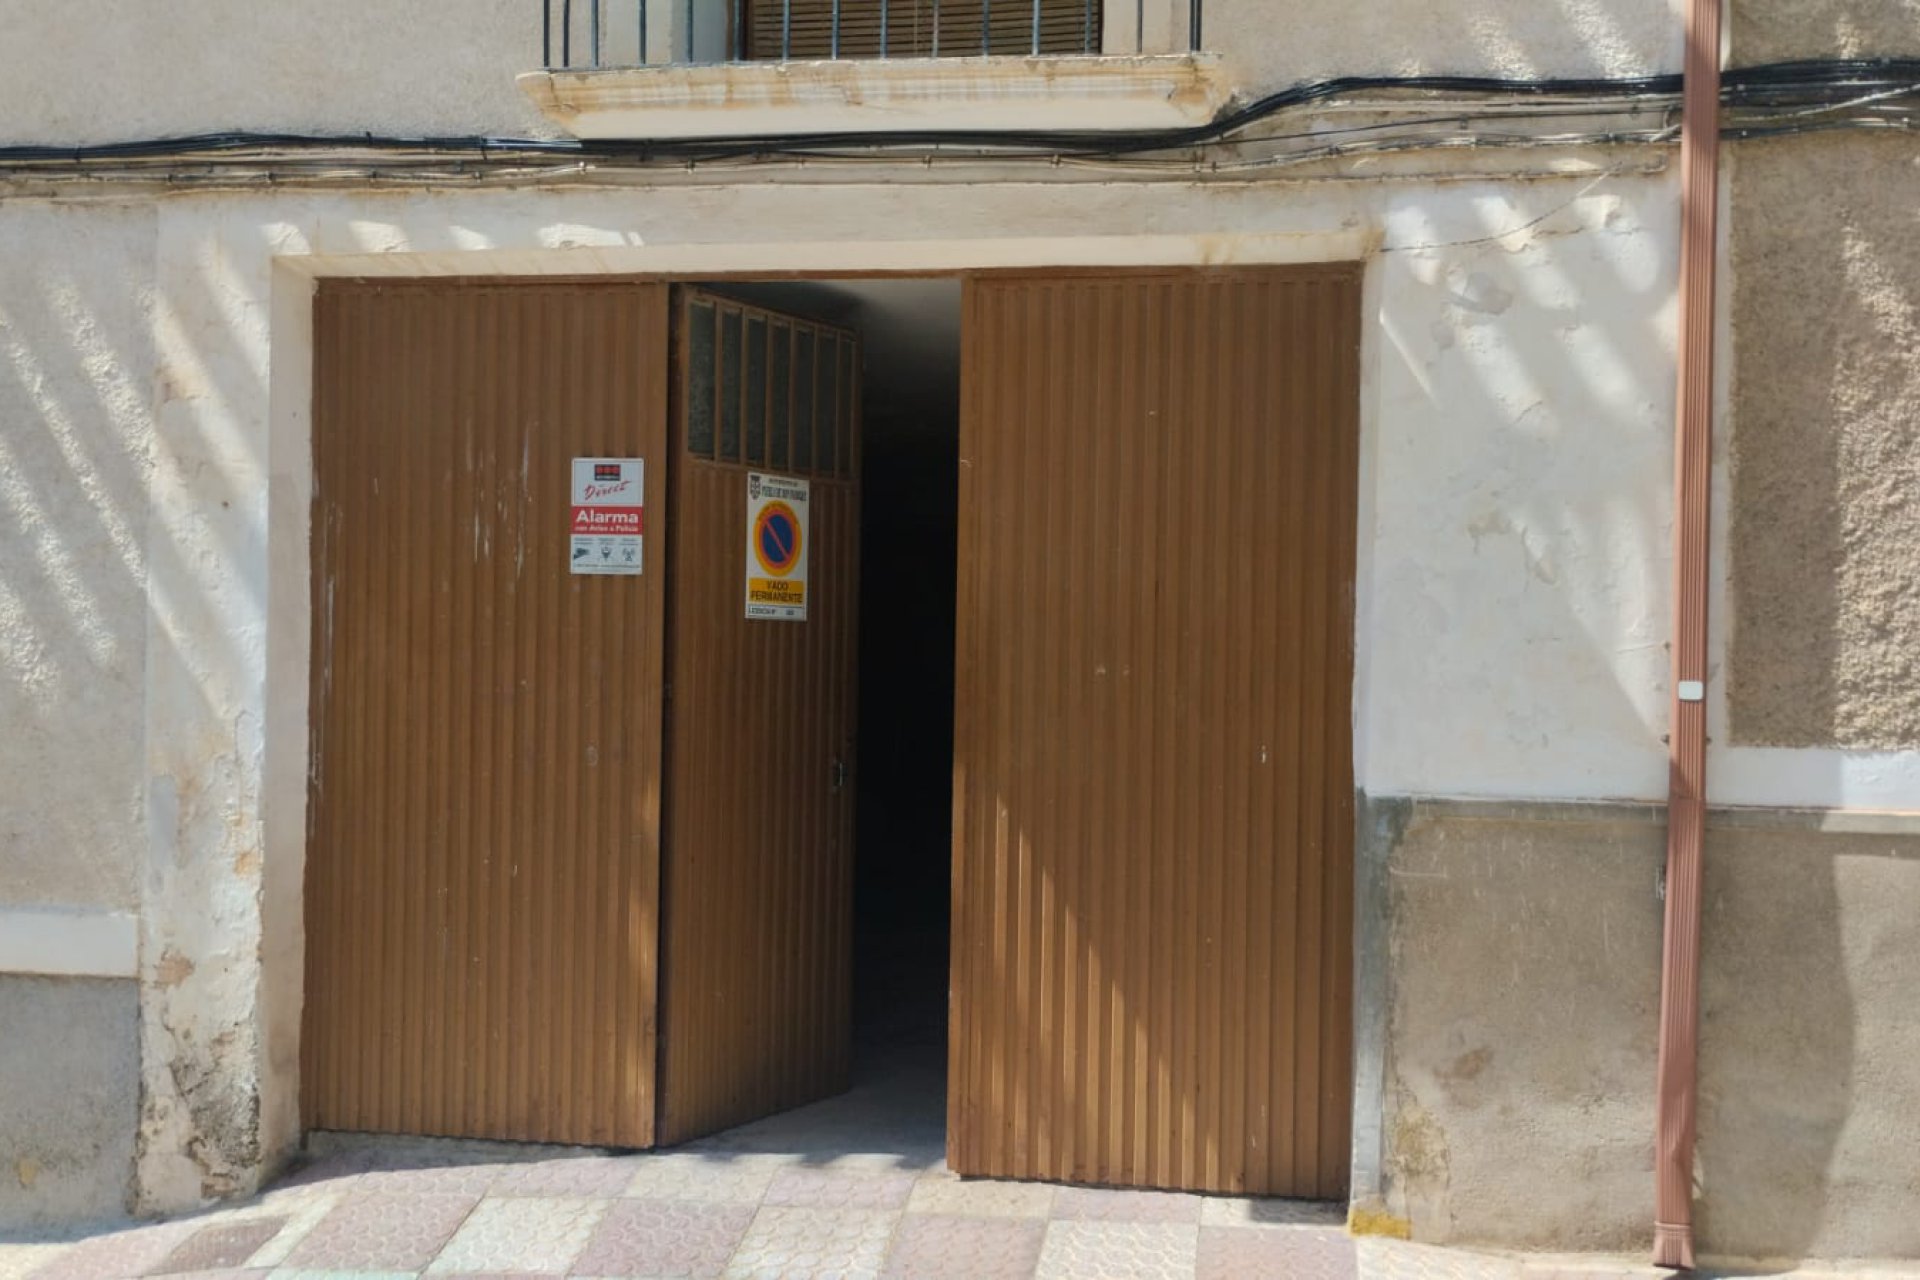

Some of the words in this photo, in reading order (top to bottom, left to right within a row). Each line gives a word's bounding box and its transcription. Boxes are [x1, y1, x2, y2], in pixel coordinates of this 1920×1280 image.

[576, 508, 639, 524] Alarma
[768, 579, 790, 591] VADO
[751, 590, 803, 603] PERMANENTE
